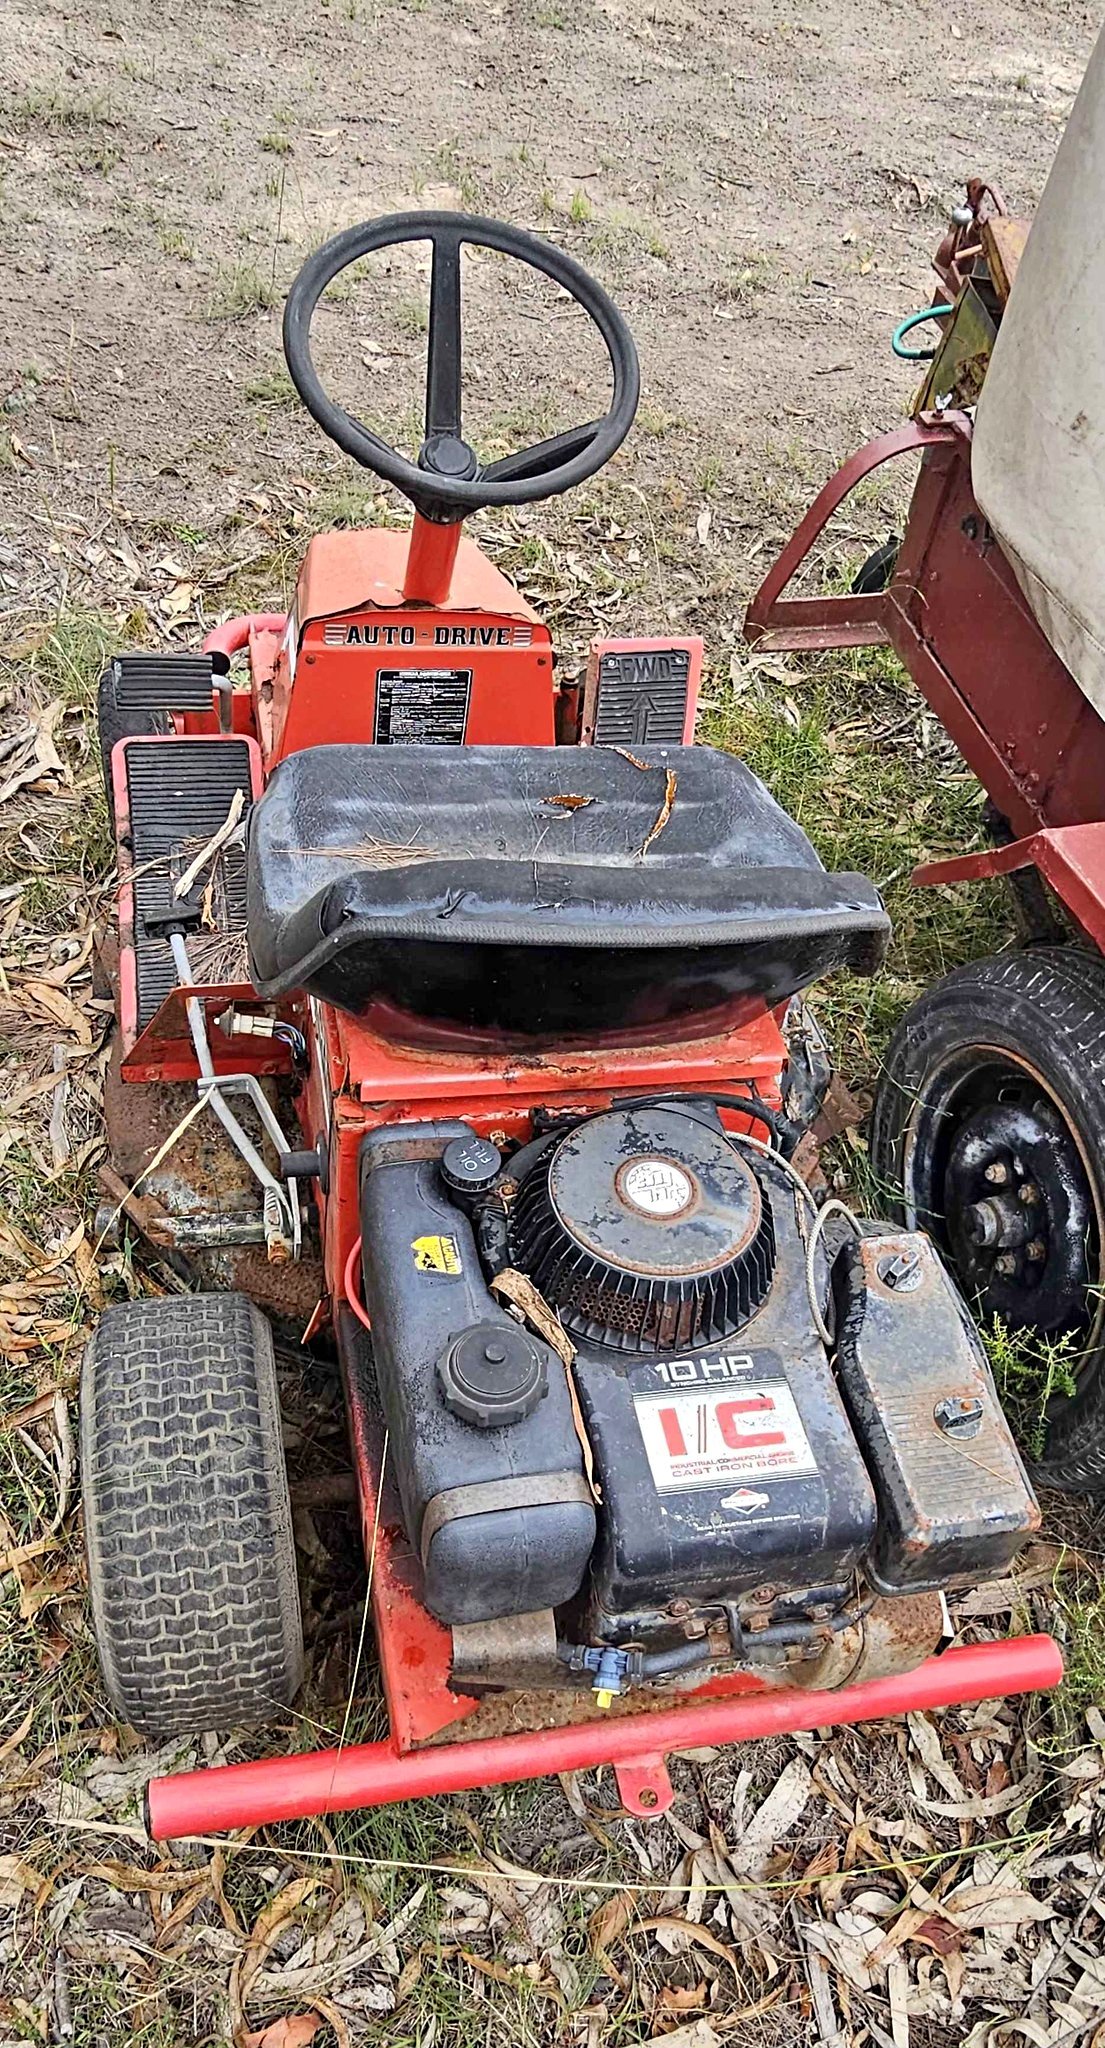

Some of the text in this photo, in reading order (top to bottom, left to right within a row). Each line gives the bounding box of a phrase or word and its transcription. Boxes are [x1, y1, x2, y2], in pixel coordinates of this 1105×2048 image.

[346, 625, 416, 645] AUTO
[433, 626, 513, 646] DRIVE
[620, 656, 671, 681] FWD
[459, 1150, 478, 1171] OIL
[469, 1140, 493, 1164] FILL
[654, 1354, 754, 1383] 10 HP
[671, 1456, 799, 1478] CAST IRON BORE
